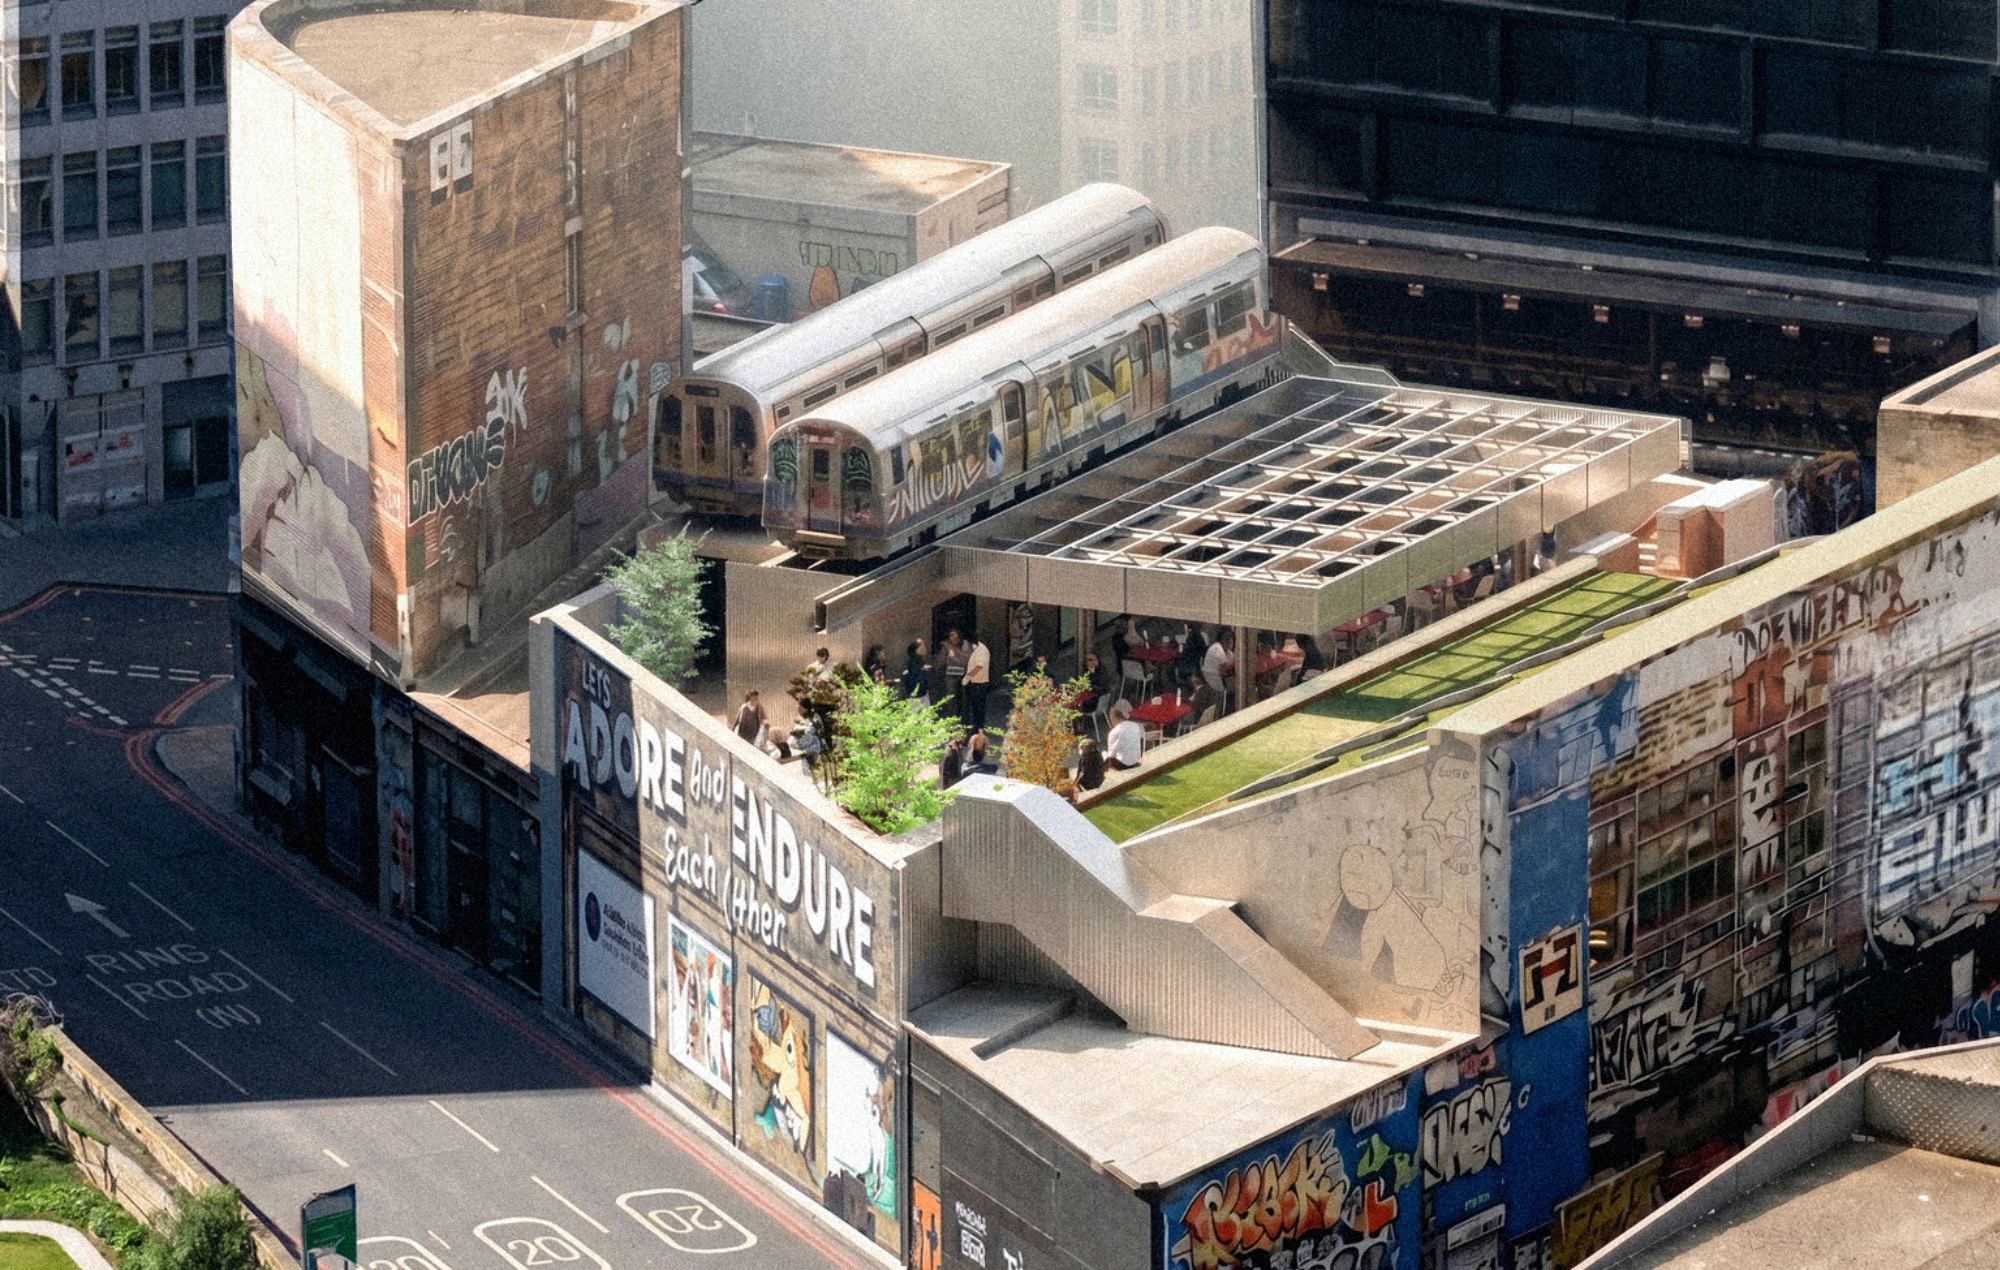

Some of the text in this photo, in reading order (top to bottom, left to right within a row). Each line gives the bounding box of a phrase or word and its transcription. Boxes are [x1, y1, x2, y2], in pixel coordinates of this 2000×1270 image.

[564, 700, 686, 816] ADORE
[732, 773, 875, 989] ENDURE
[85, 944, 210, 975] RING
[123, 972, 249, 1003] ROAD
[196, 1004, 262, 1030] (N)
[647, 1205, 722, 1234] 20
[507, 1235, 582, 1266] 20
